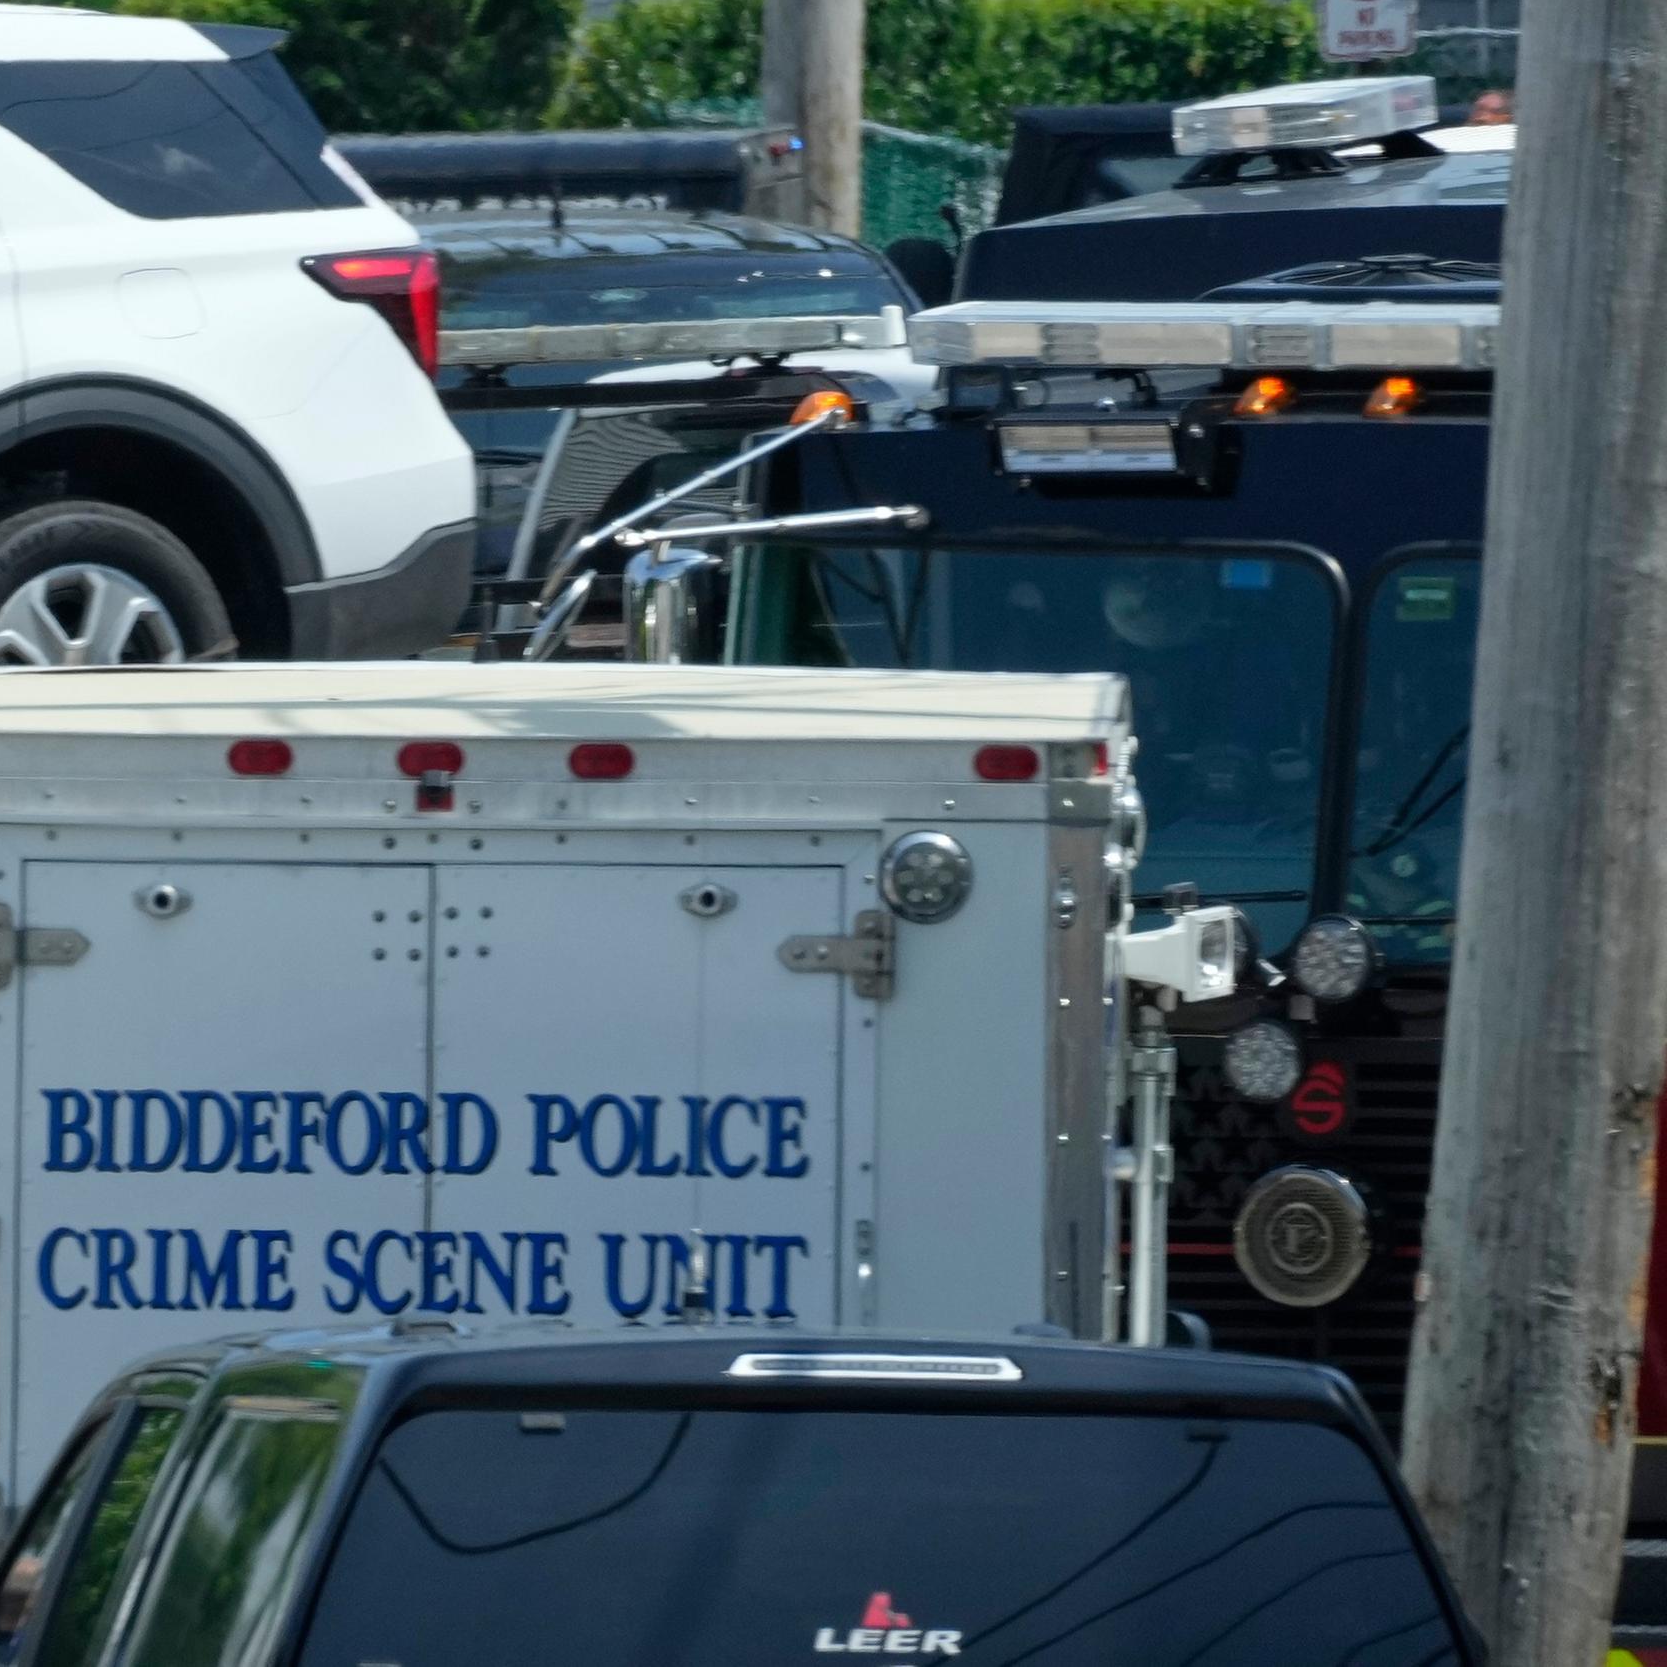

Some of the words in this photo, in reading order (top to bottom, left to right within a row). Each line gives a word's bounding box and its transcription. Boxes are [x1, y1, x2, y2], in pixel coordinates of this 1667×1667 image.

[40, 1088, 499, 1176] BIDDEFORD
[526, 1091, 809, 1179] POLICE
[36, 1227, 296, 1312] CRIME
[323, 1229, 571, 1316] SCENE
[598, 1232, 810, 1318] UNIT
[814, 1627, 962, 1655] LEER
